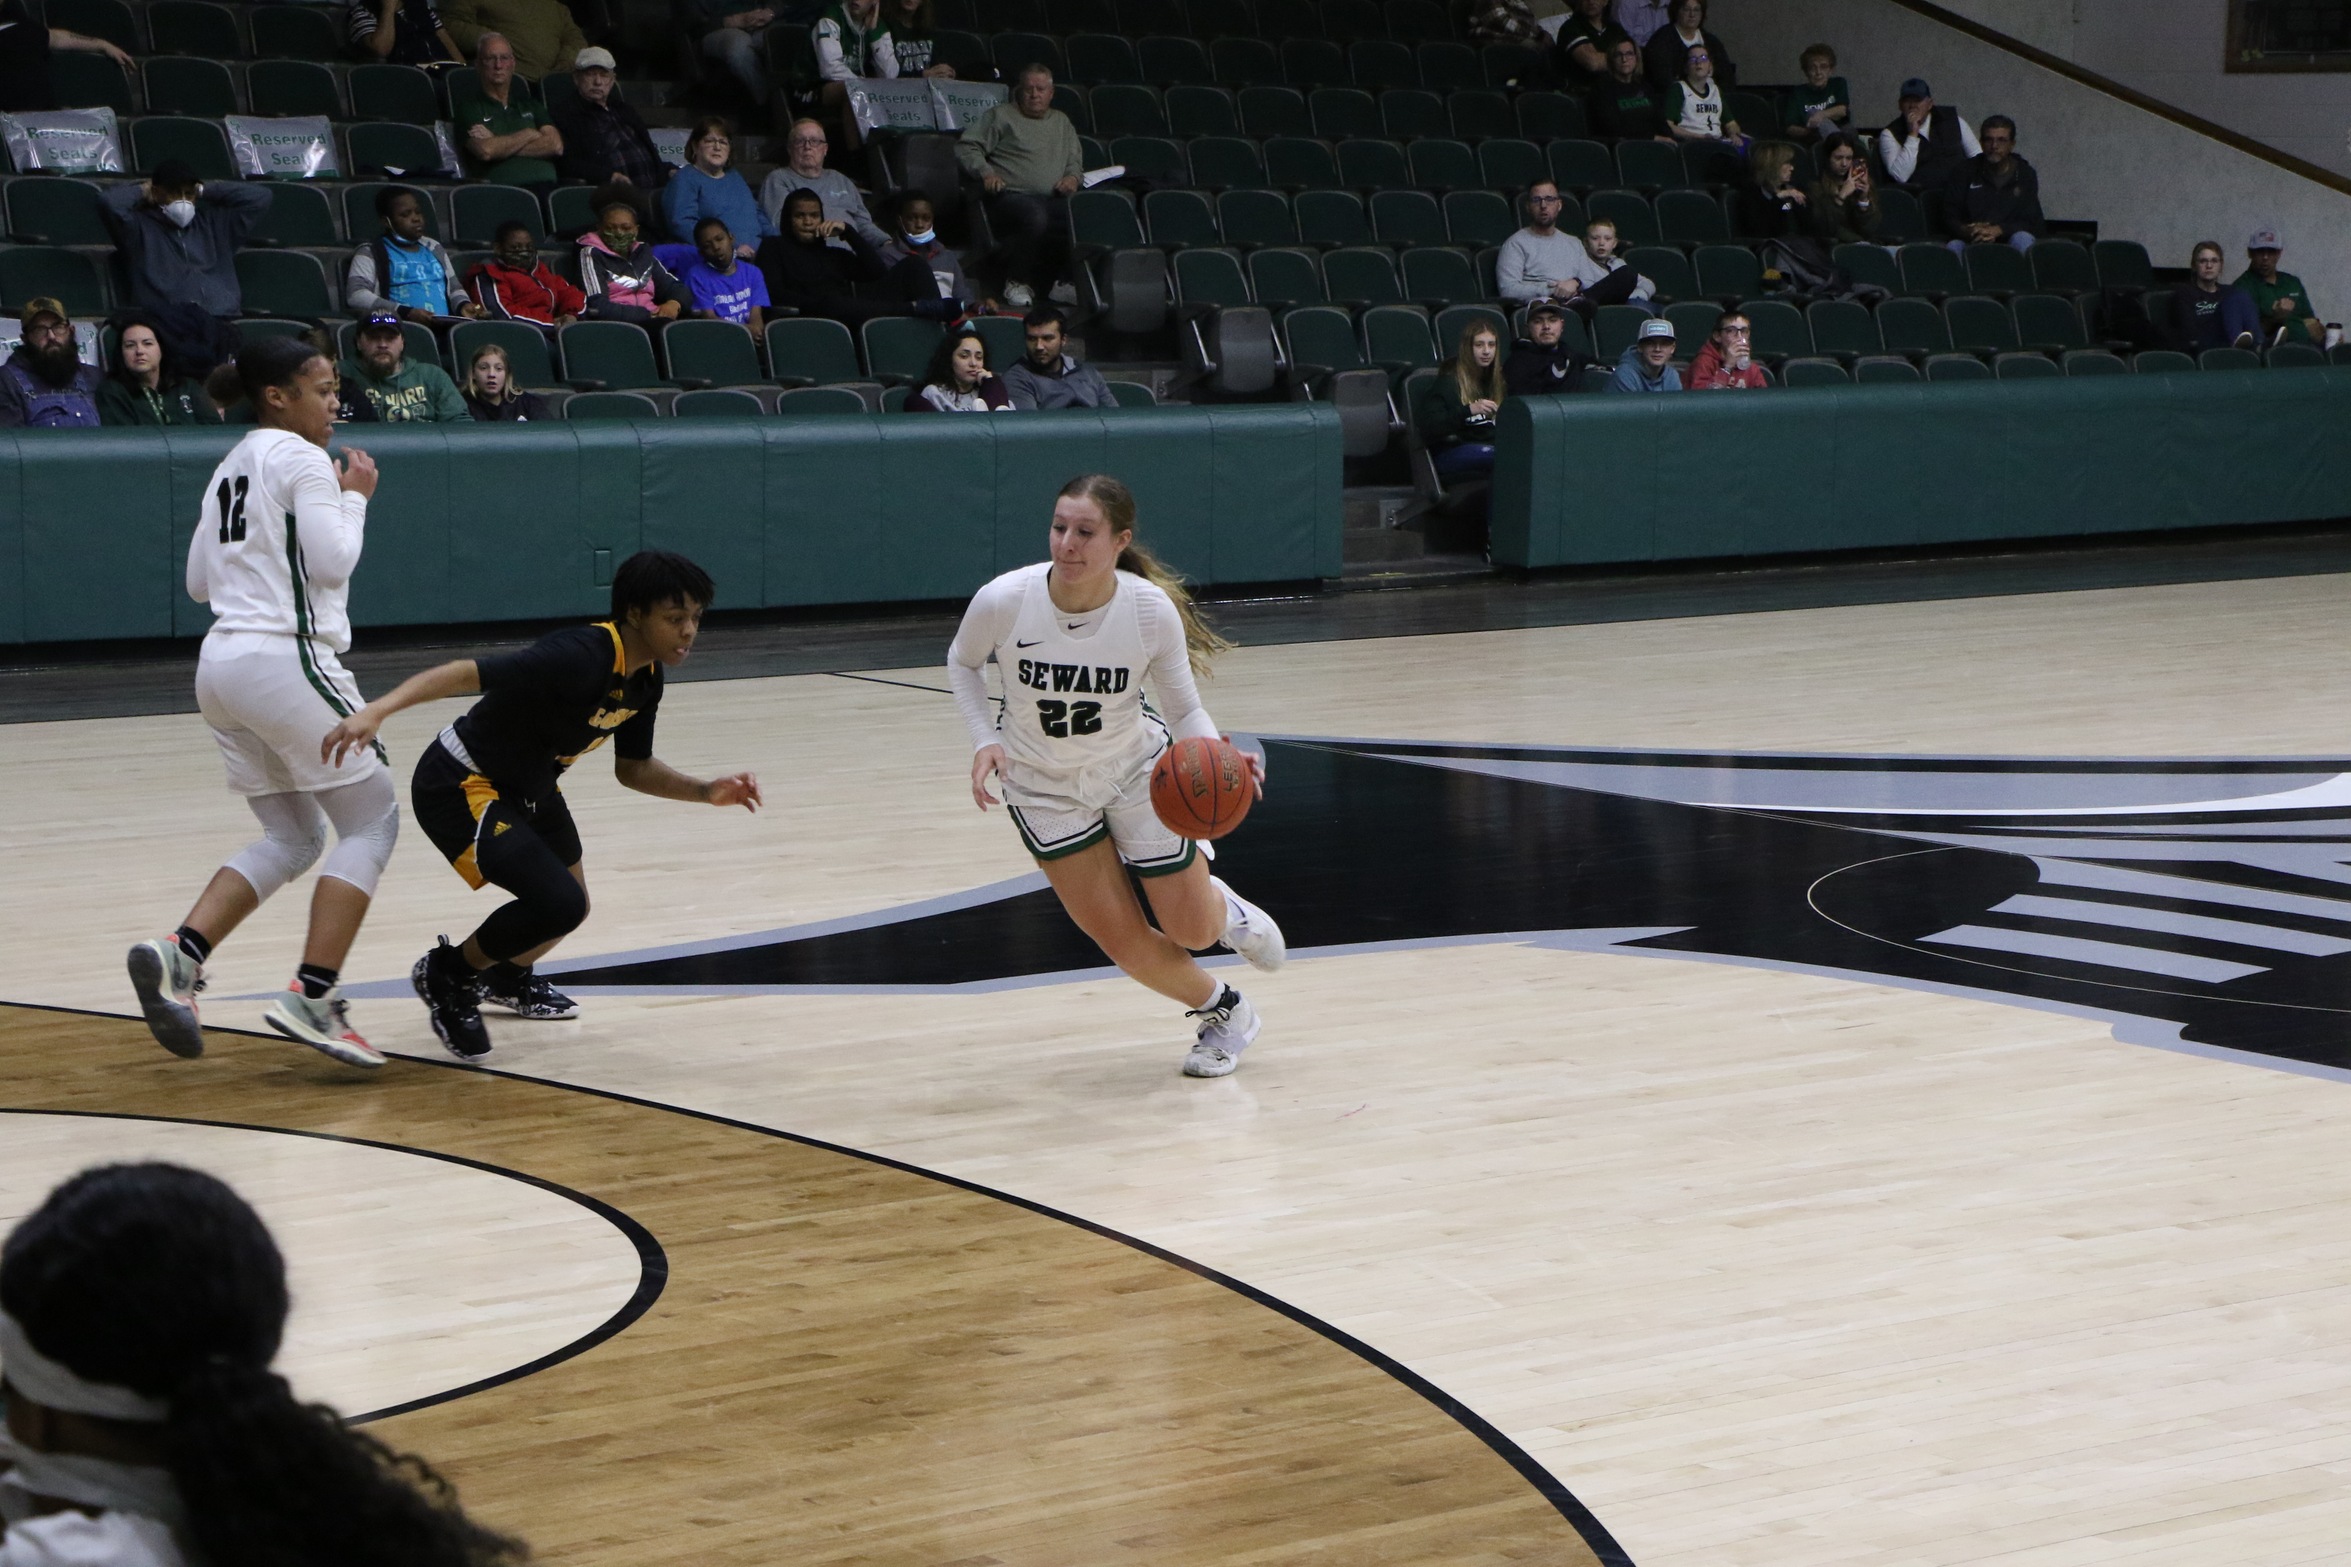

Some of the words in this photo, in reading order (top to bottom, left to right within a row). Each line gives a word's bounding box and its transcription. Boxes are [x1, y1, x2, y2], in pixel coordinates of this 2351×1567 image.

[251, 133, 327, 146] Reserved
[216, 475, 249, 544] 12
[1018, 658, 1130, 695] SEWARD
[1035, 698, 1103, 738] 22
